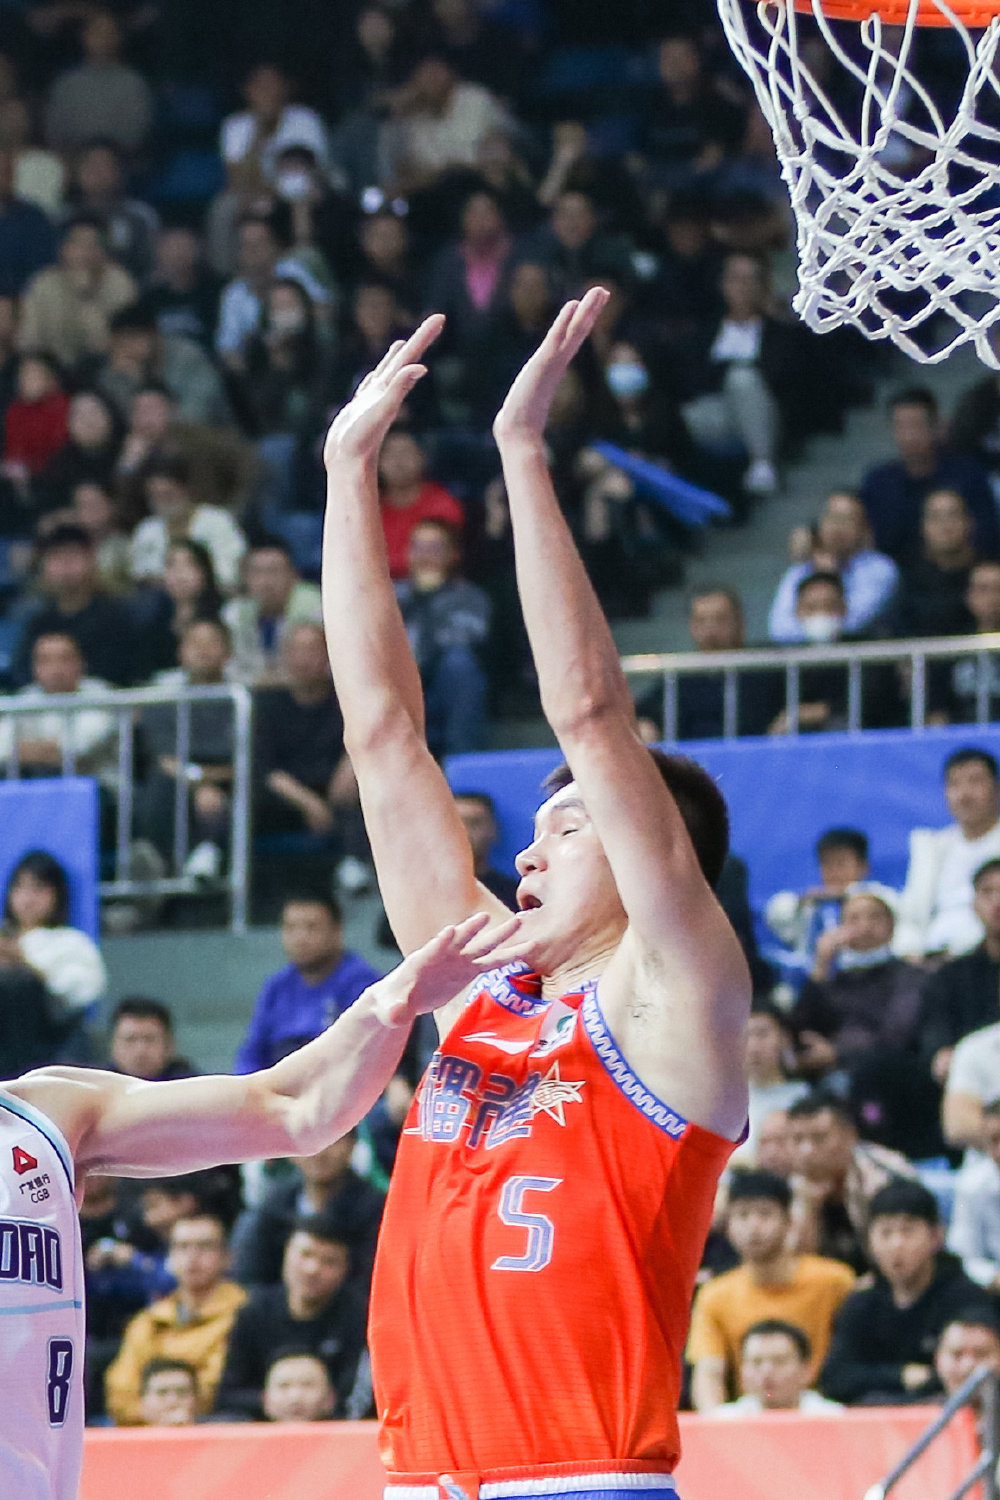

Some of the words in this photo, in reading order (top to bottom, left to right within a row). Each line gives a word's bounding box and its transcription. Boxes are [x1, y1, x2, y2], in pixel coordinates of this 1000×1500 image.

[30, 1188, 51, 1204] CGB
[490, 1175, 563, 1272] 5
[47, 1335, 75, 1428] 8
